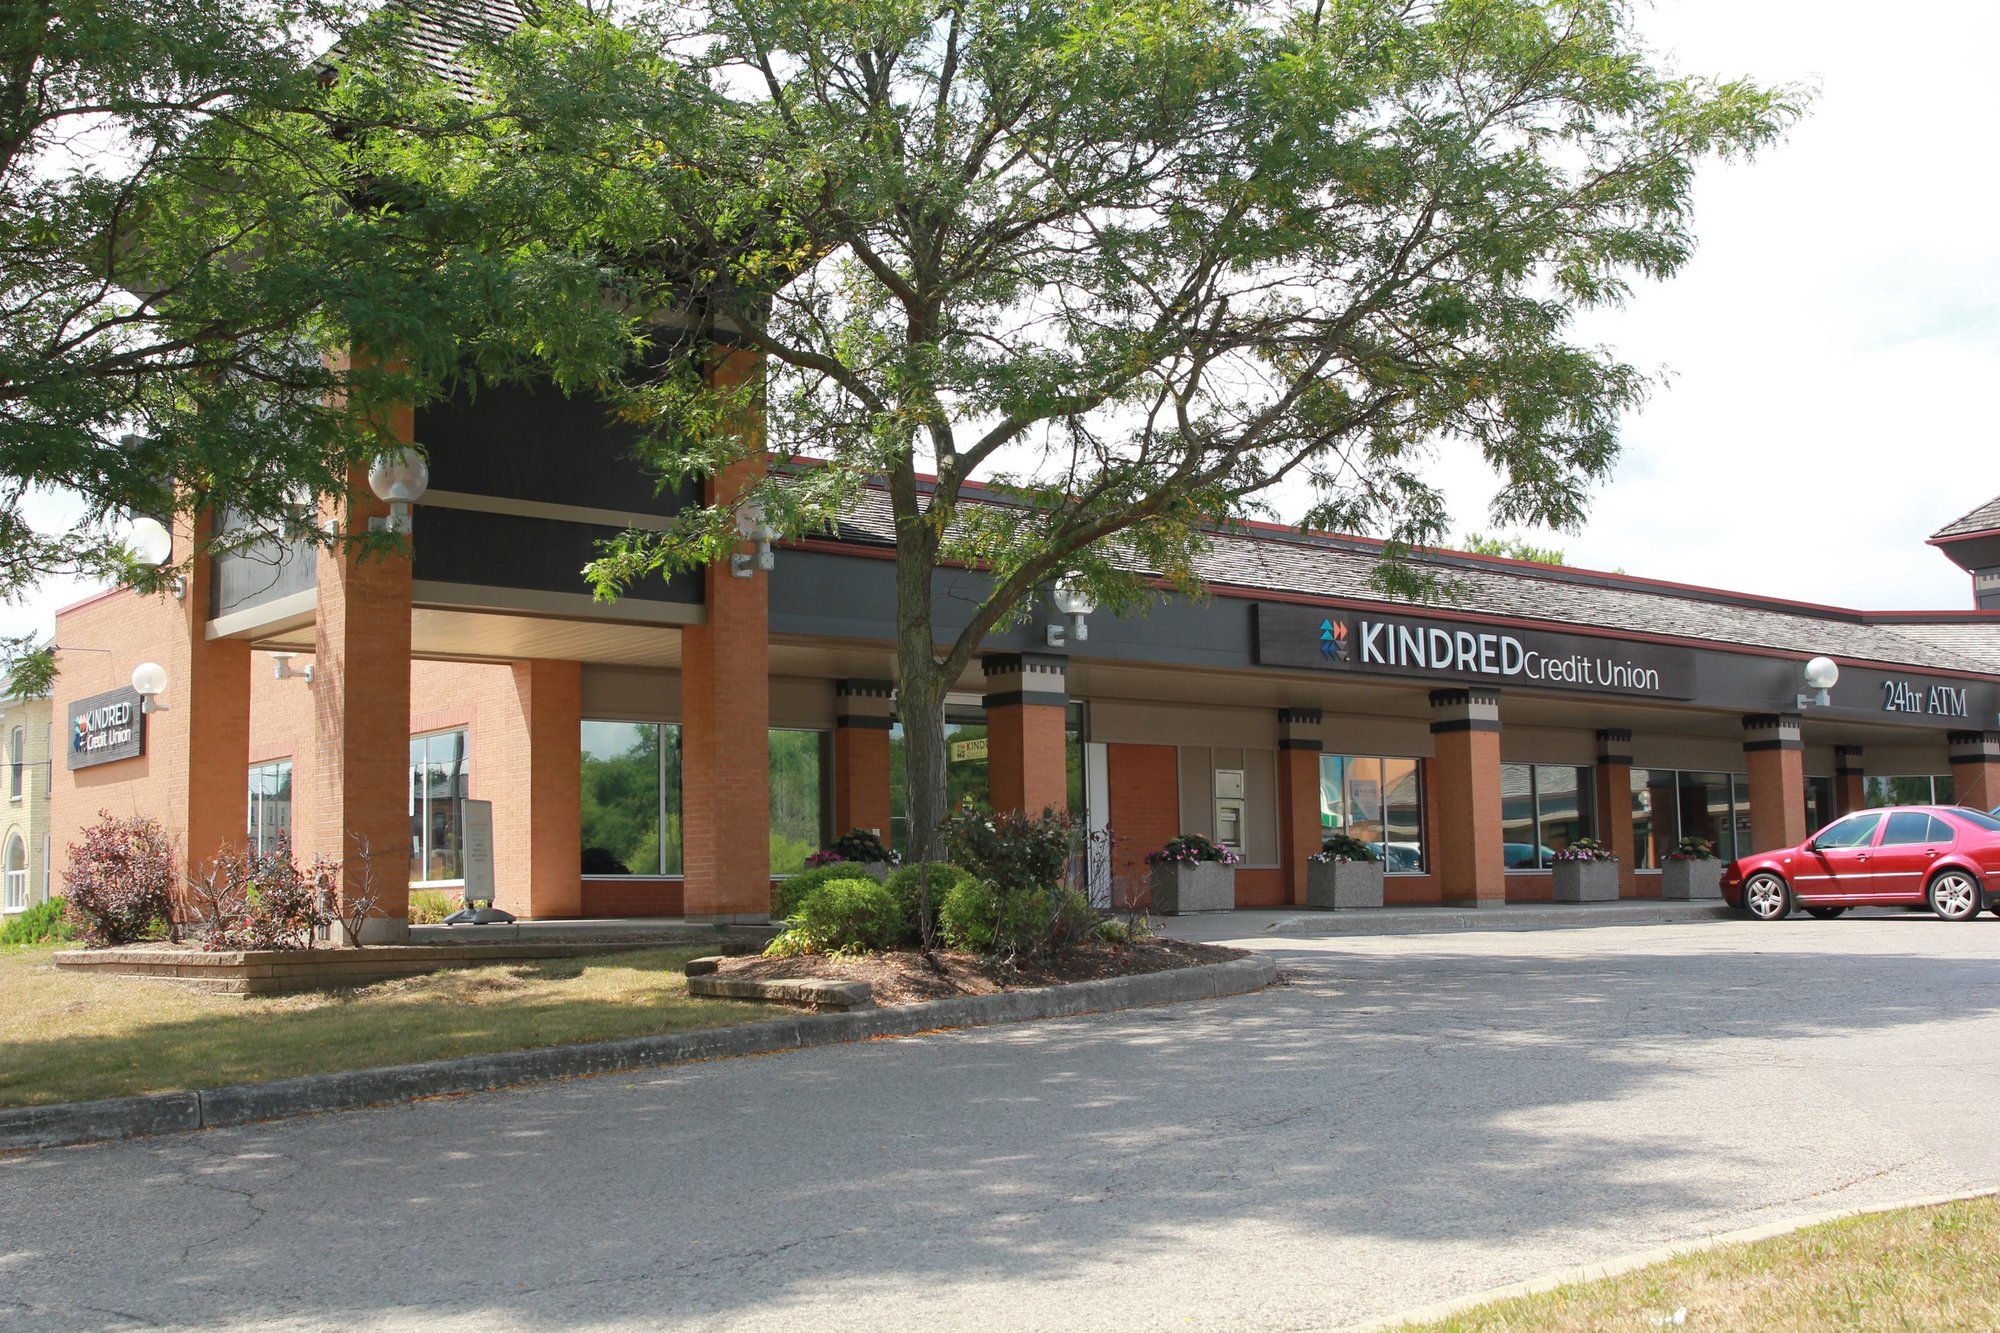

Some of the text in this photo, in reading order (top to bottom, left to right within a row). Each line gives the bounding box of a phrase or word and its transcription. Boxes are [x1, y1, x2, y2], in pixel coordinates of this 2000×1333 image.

[1359, 621, 1659, 690] KINDRED Credit Union
[1883, 680, 1968, 717] 24hr ATM
[86, 702, 131, 732] KINDRED
[87, 727, 131, 750] Credit Union
